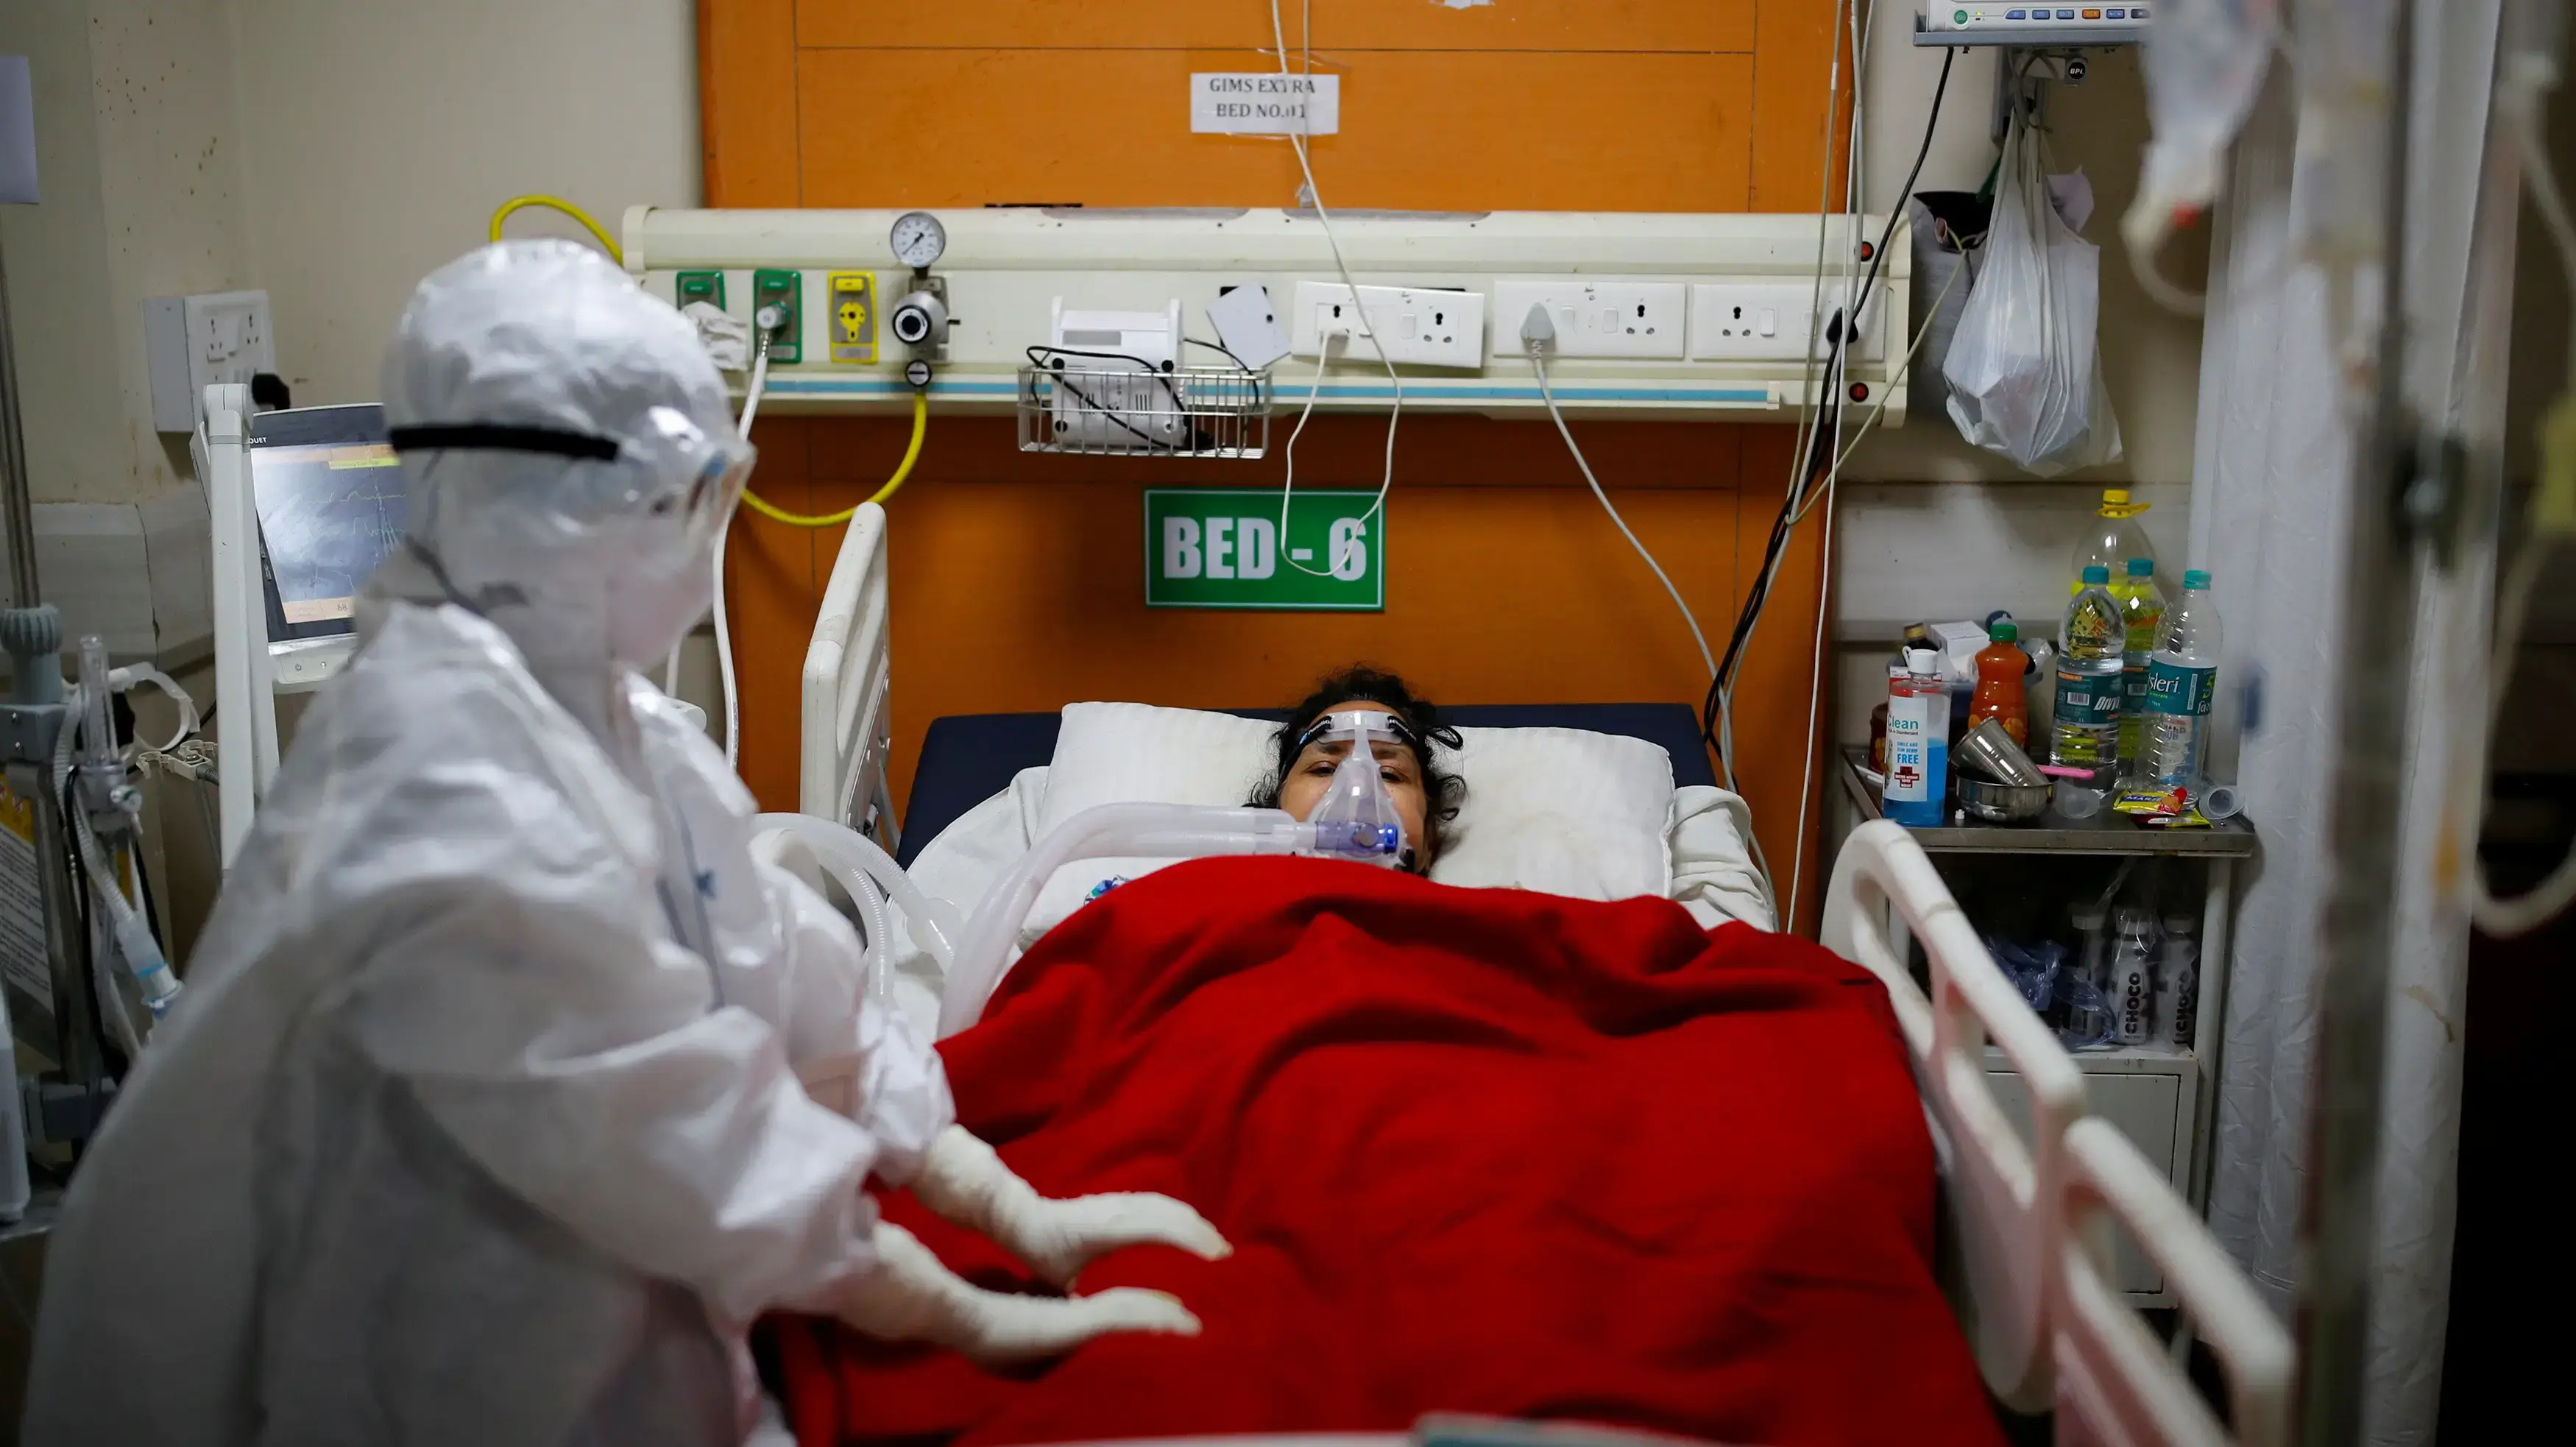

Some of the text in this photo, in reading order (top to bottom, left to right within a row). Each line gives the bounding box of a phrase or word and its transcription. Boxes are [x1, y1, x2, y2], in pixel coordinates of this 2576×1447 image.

[1209, 78, 1253, 93] GIMS
[1216, 103, 1251, 118] BED
[1163, 517, 1275, 579] BED
[1328, 517, 1367, 581] 6
[1888, 713, 1919, 730] Clean
[1897, 753, 1919, 765] FREE
[2125, 972, 2141, 1034] CHOCO
